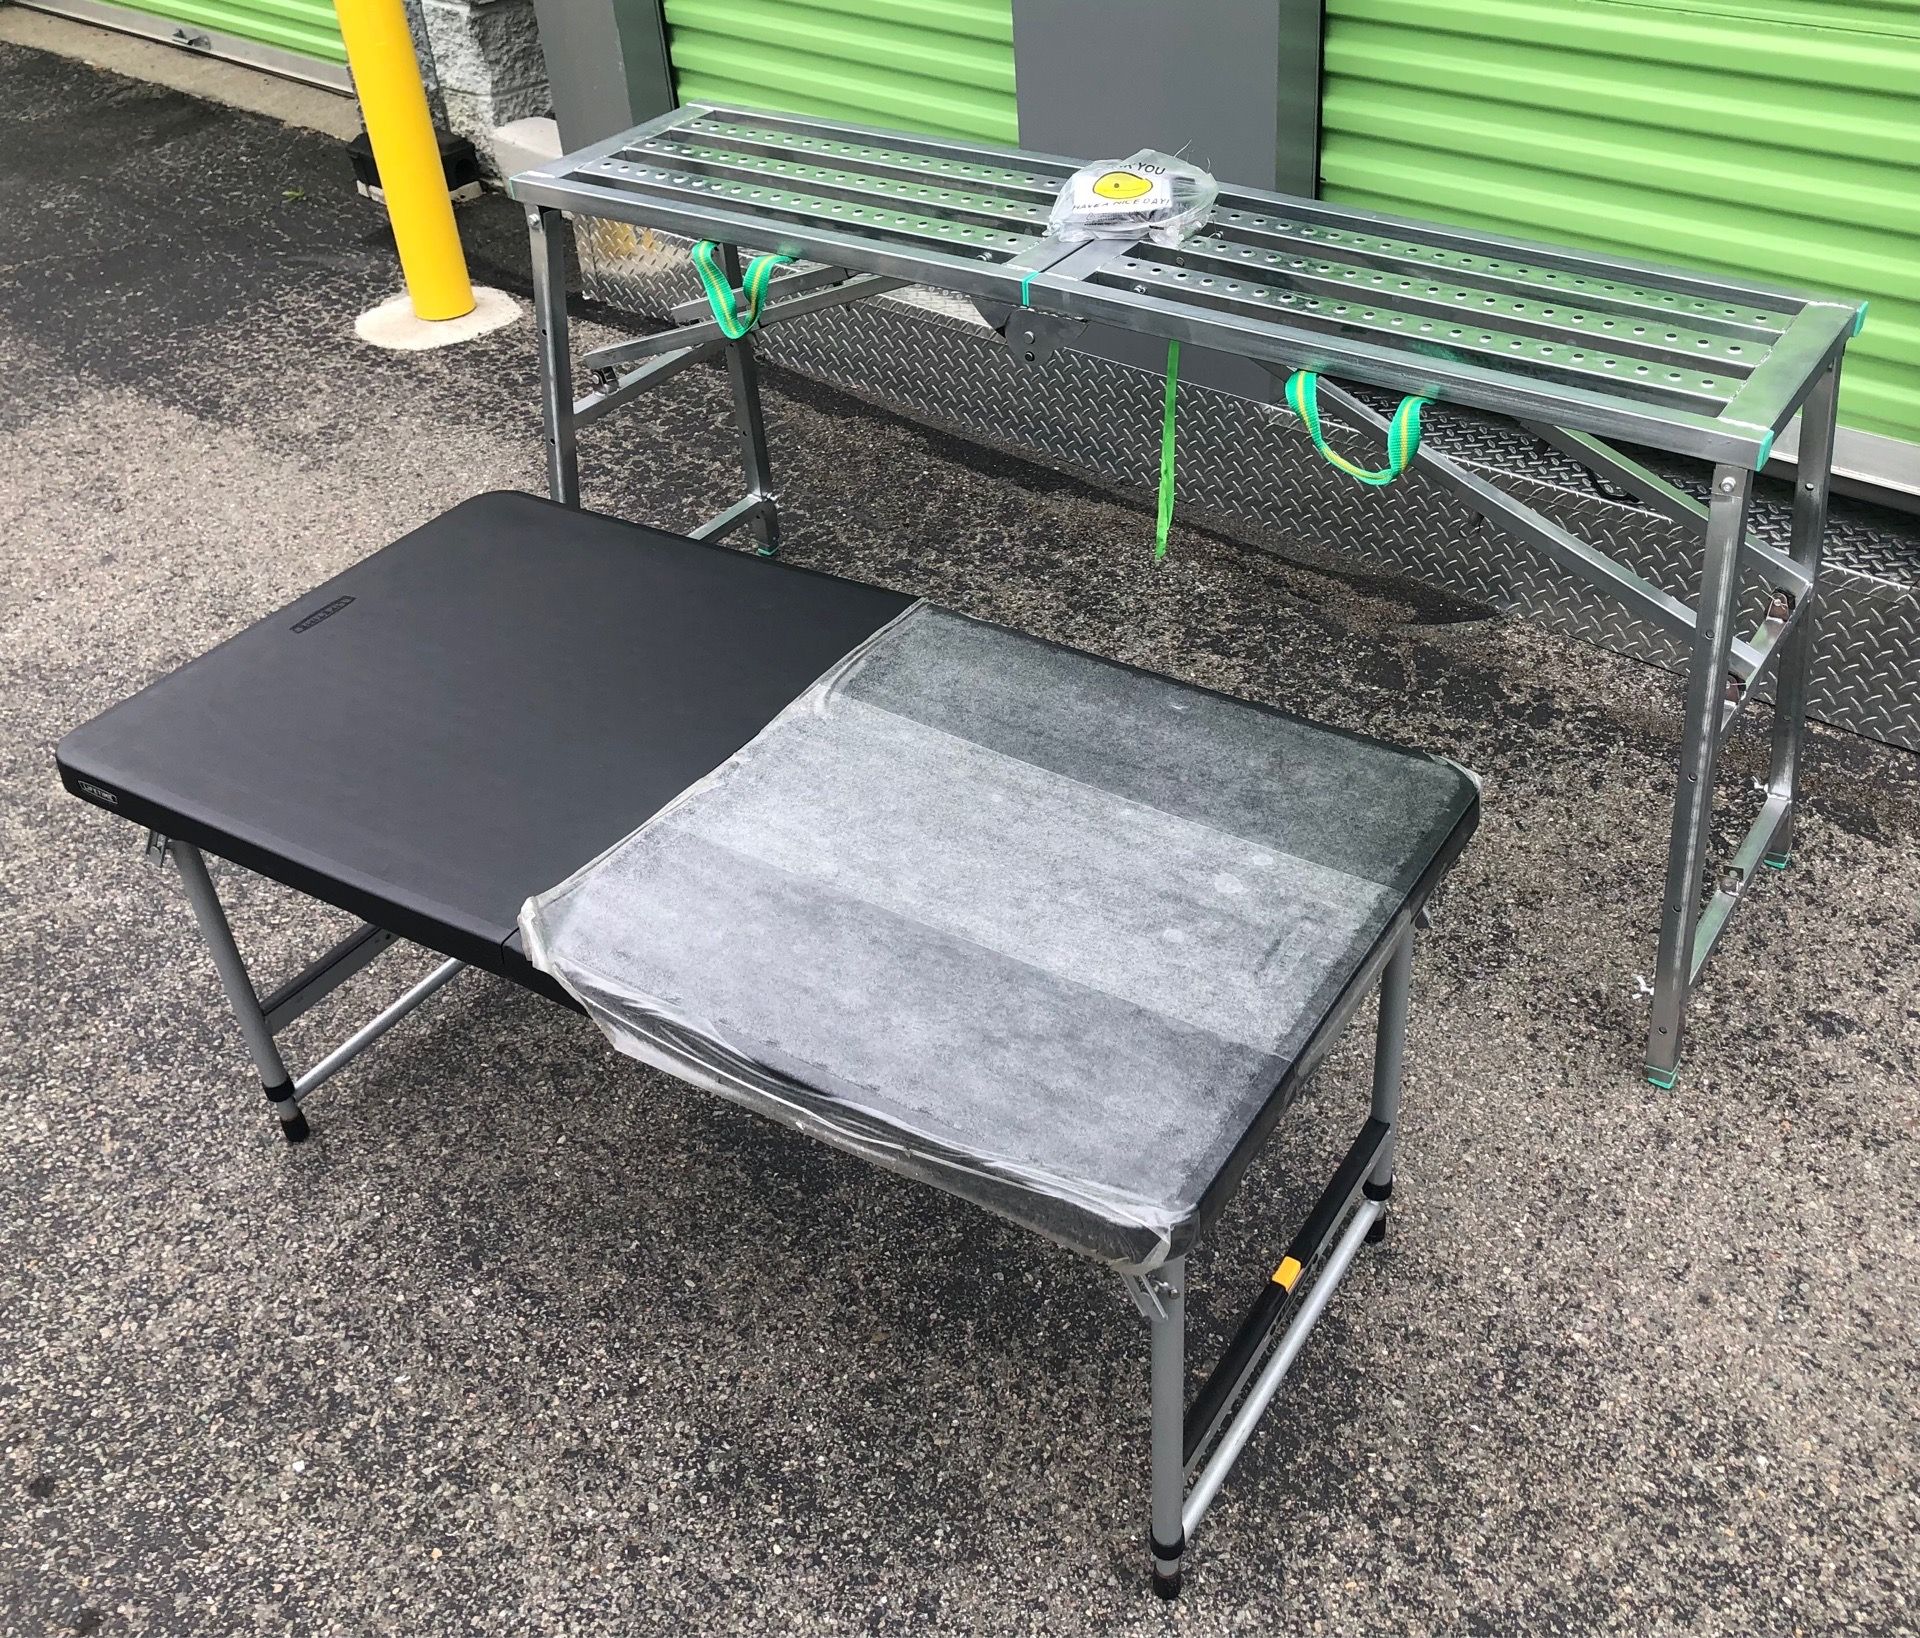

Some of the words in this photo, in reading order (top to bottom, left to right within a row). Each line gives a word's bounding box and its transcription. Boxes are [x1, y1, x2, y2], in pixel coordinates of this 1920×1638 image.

[1137, 162, 1166, 175] YOU
[1072, 203, 1099, 211] HAVE
[1143, 198, 1170, 206] DAY!
